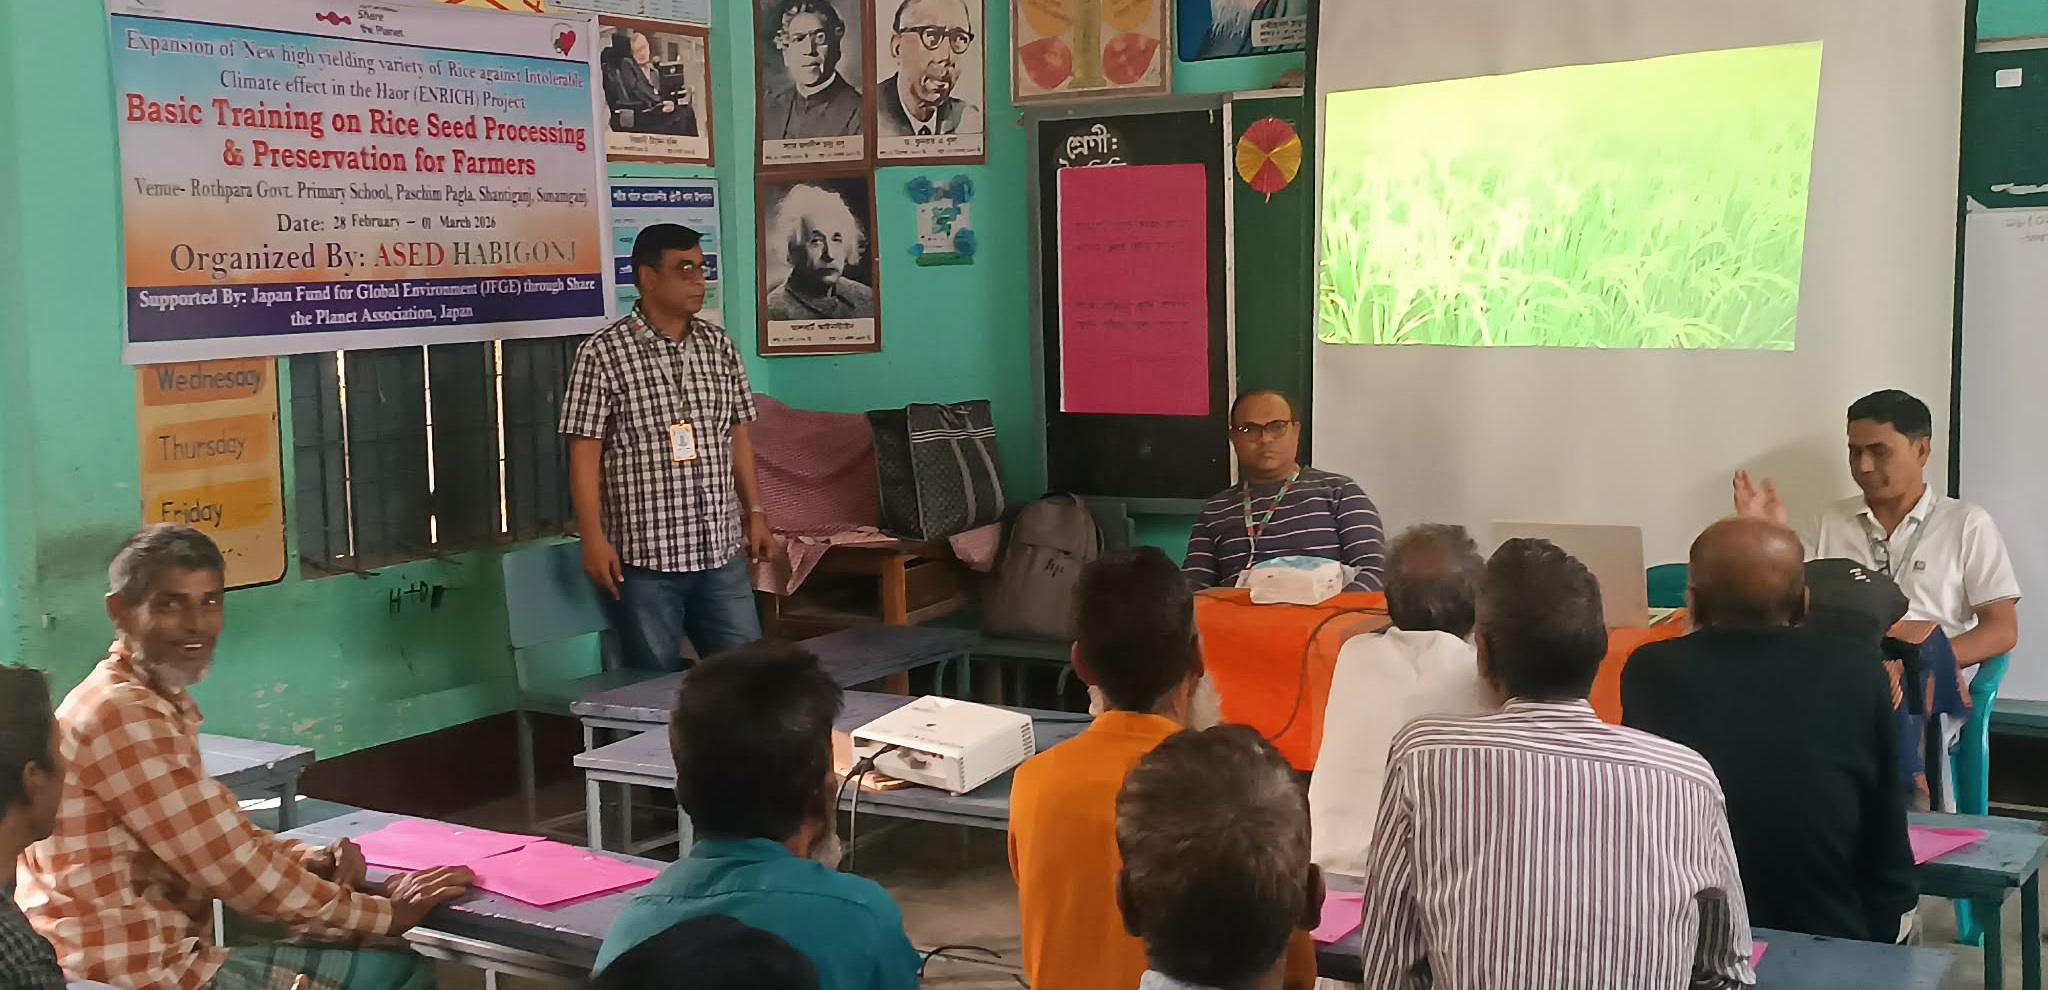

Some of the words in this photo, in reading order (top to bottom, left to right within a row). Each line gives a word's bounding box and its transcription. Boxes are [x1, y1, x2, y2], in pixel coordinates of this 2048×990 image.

[127, 29, 214, 56] Expansion
[219, 39, 235, 57] of
[242, 40, 275, 59] New
[282, 44, 314, 67] high
[319, 49, 375, 74] yielding
[379, 56, 424, 79] variety
[430, 59, 442, 75] of
[449, 61, 475, 79] Rice
[480, 66, 520, 84] against
[525, 67, 584, 88] Intolerable
[220, 69, 281, 92] Climate
[286, 75, 328, 96] effect
[332, 78, 345, 97] in
[350, 80, 372, 98] the
[376, 82, 410, 101] Haor
[414, 85, 480, 107] (ENRICH)
[483, 91, 526, 112] Project
[126, 93, 203, 125] Basic
[212, 98, 325, 139] Training
[331, 112, 361, 134] on
[369, 108, 419, 136] Rice
[427, 112, 478, 139] Seed
[484, 116, 586, 151] Processing
[223, 138, 244, 167] &
[253, 139, 407, 171] Preservation
[415, 146, 445, 173] for
[452, 149, 536, 175] Farmers
[134, 177, 185, 197] Venue-
[191, 178, 252, 204] Rothpara
[297, 181, 345, 205] Primary
[397, 184, 442, 201] Paschim
[277, 213, 325, 232] Date:
[334, 216, 346, 230] 28
[352, 213, 400, 231] February
[422, 217, 431, 229] 01
[440, 215, 471, 229] March
[475, 215, 496, 229] 2026
[170, 243, 315, 280] Organized
[327, 242, 365, 277] By:
[374, 242, 445, 267] ASED
[453, 240, 576, 265] HABIGONJ
[139, 288, 217, 311] Supported
[222, 288, 247, 308] By:
[251, 287, 292, 307] Japan
[296, 286, 330, 302] Fund
[334, 284, 353, 300] for
[356, 283, 399, 299] Global
[403, 282, 477, 298] Environment
[480, 280, 521, 297] (JFGE)
[524, 278, 564, 296] through
[567, 278, 595, 292] Share
[290, 311, 312, 326] the
[315, 309, 357, 325] Planet
[361, 305, 437, 323] Association,
[439, 304, 473, 321] Japan
[156, 364, 261, 394] Wednesday
[159, 430, 246, 461] Thursday
[161, 500, 223, 528] Friday
